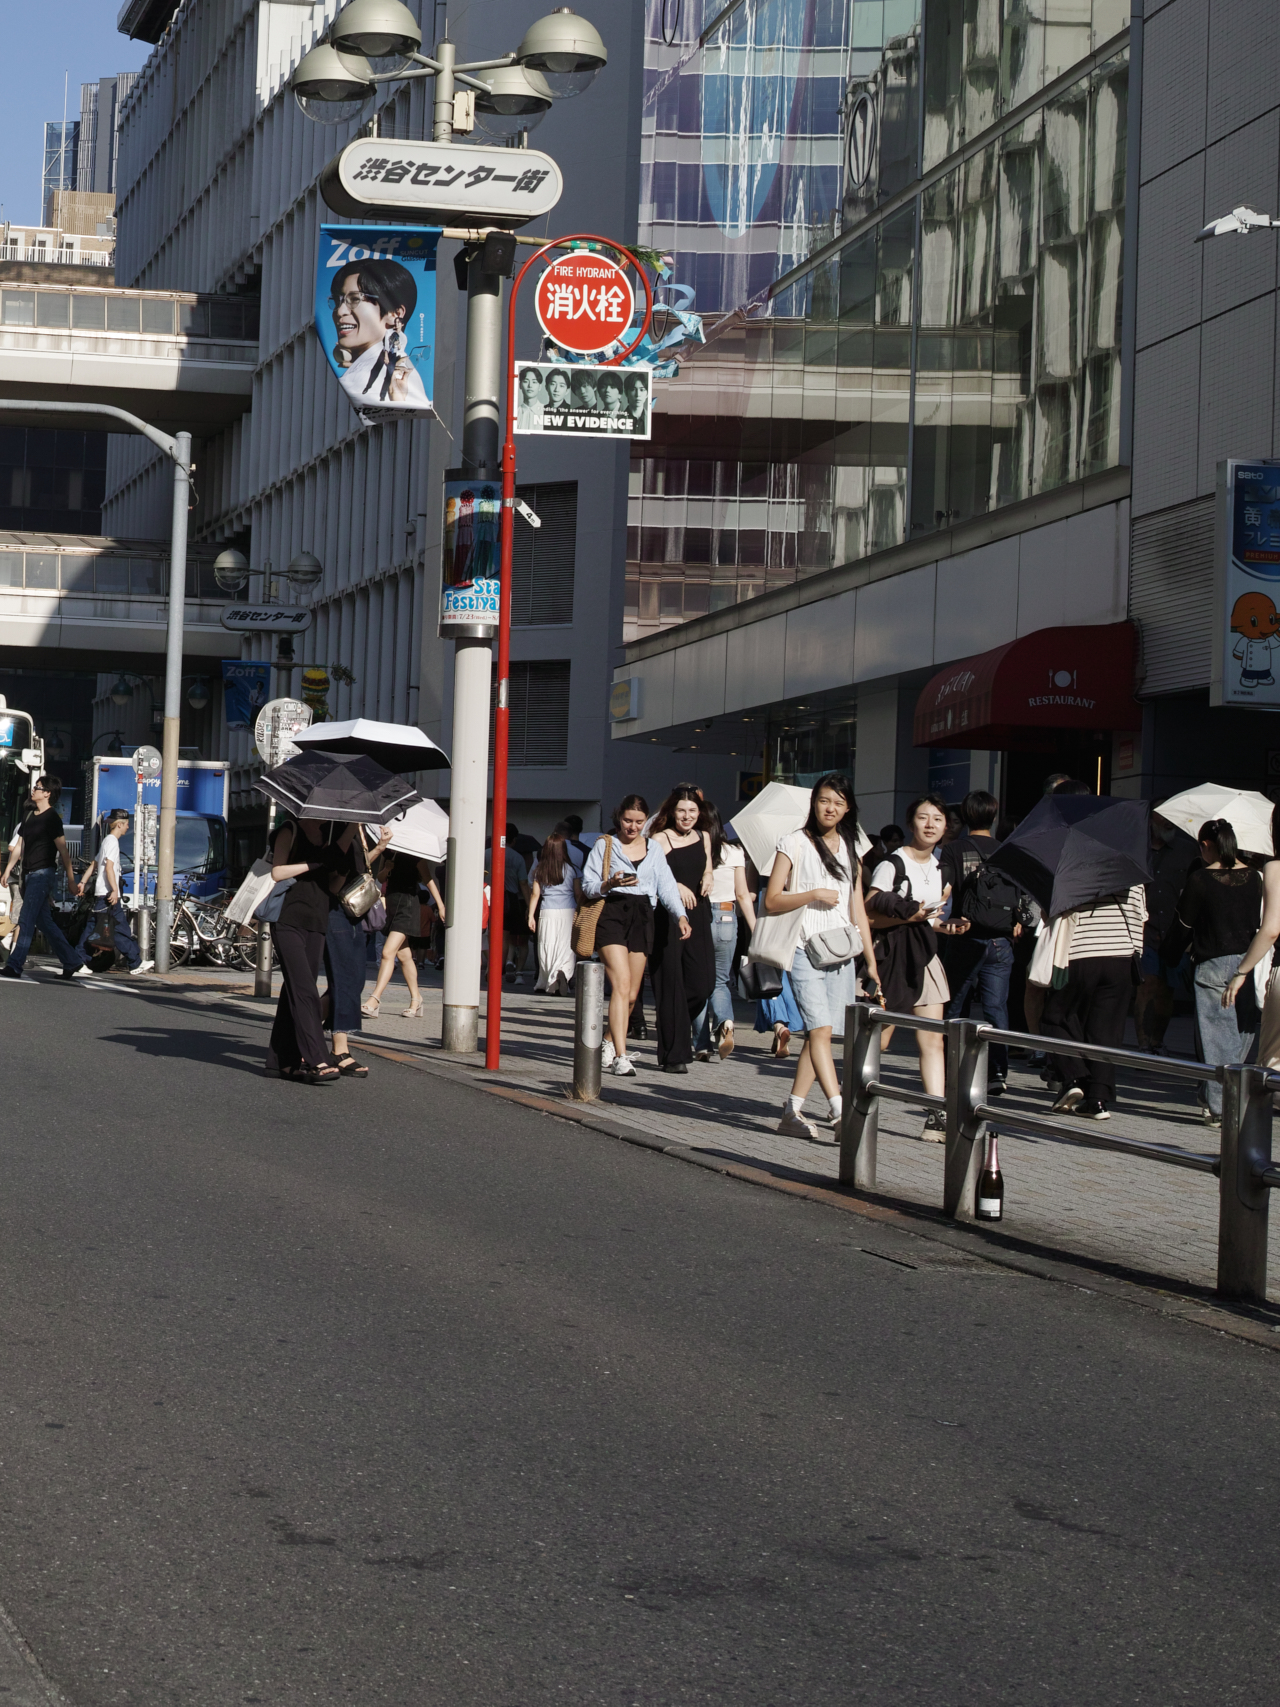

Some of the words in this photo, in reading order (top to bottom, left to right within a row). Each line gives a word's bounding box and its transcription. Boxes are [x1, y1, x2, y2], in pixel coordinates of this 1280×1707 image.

[352, 157, 550, 194] 渋谷センター街
[326, 237, 401, 268] Zoff
[554, 265, 573, 276] FIRE
[576, 267, 616, 279] HYDRANT
[546, 283, 625, 322] 消火栓
[533, 414, 564, 427] NEW
[567, 415, 633, 430] EVIDENCE
[1238, 471, 1264, 480] sato
[473, 577, 500, 595] Sta
[226, 610, 307, 623] 渋谷センター街
[226, 666, 256, 677] Zoff
[1028, 695, 1096, 709] RESTAURANT
